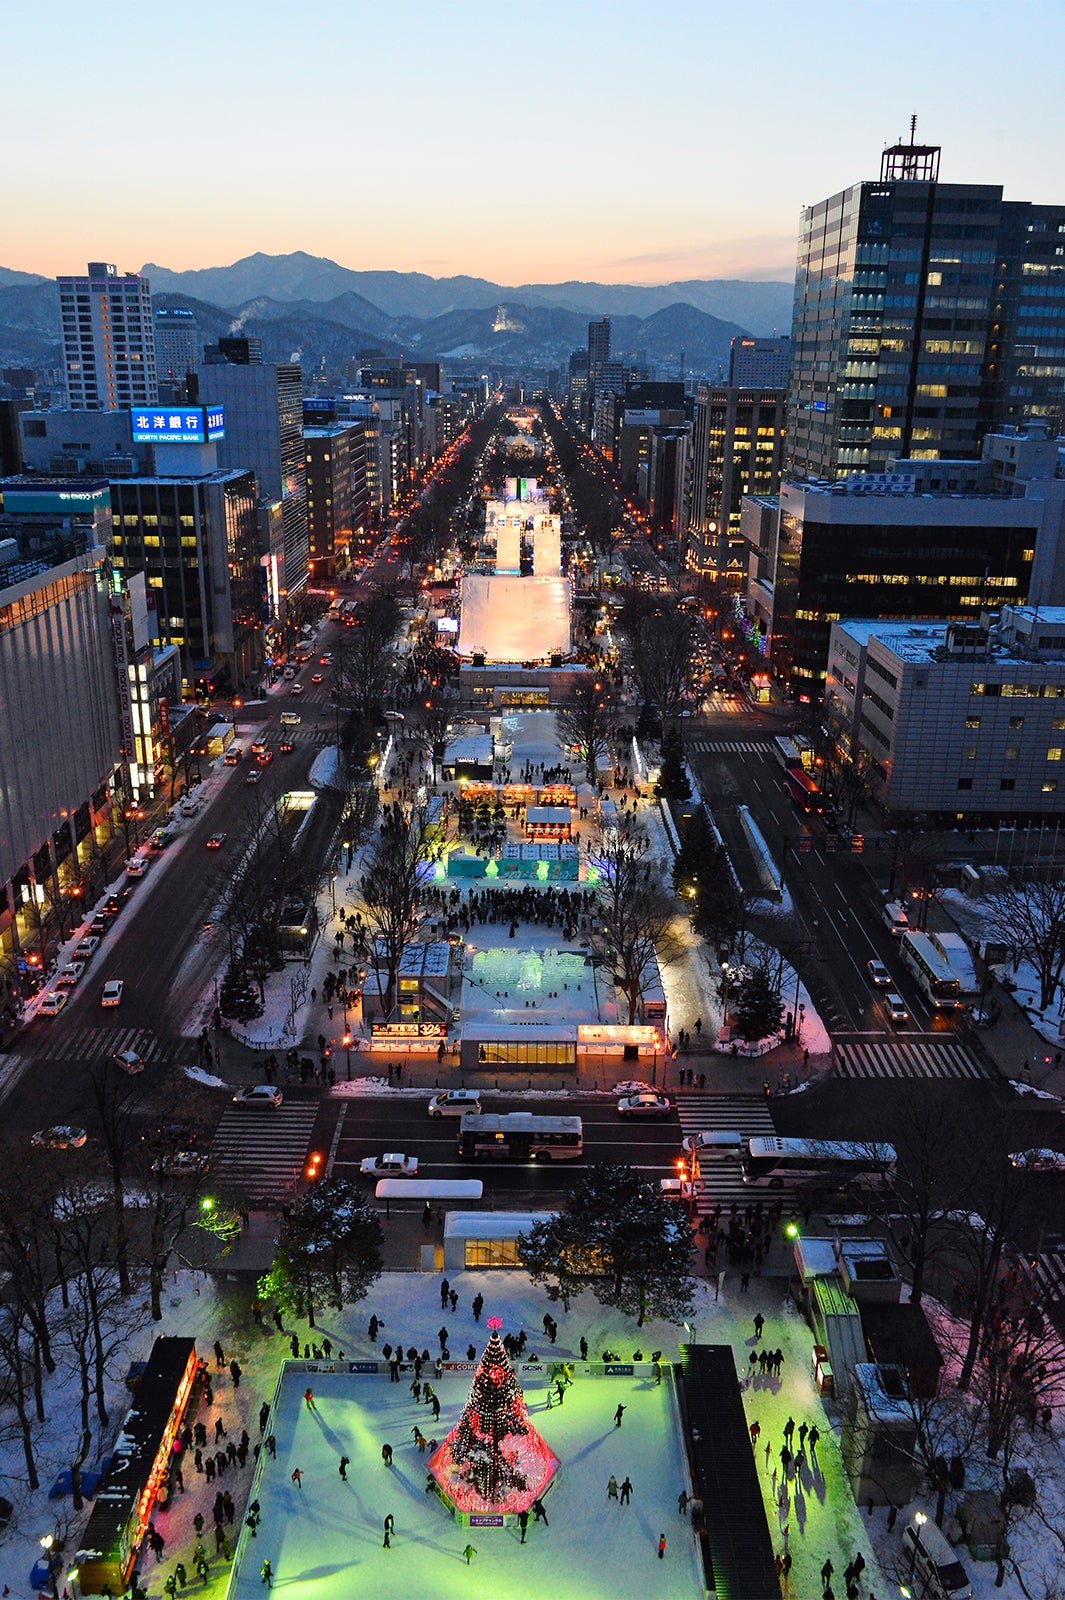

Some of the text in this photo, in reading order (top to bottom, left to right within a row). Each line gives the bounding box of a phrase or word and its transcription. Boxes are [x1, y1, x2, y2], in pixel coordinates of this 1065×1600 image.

[136, 415, 199, 429] 北洋銀行
[852, 474, 912, 482] 北海道新聞
[114, 620, 123, 645] marui
[119, 668, 130, 711] marui imai
[124, 715, 134, 757] marui imai
[521, 1364, 543, 1372] SCSK
